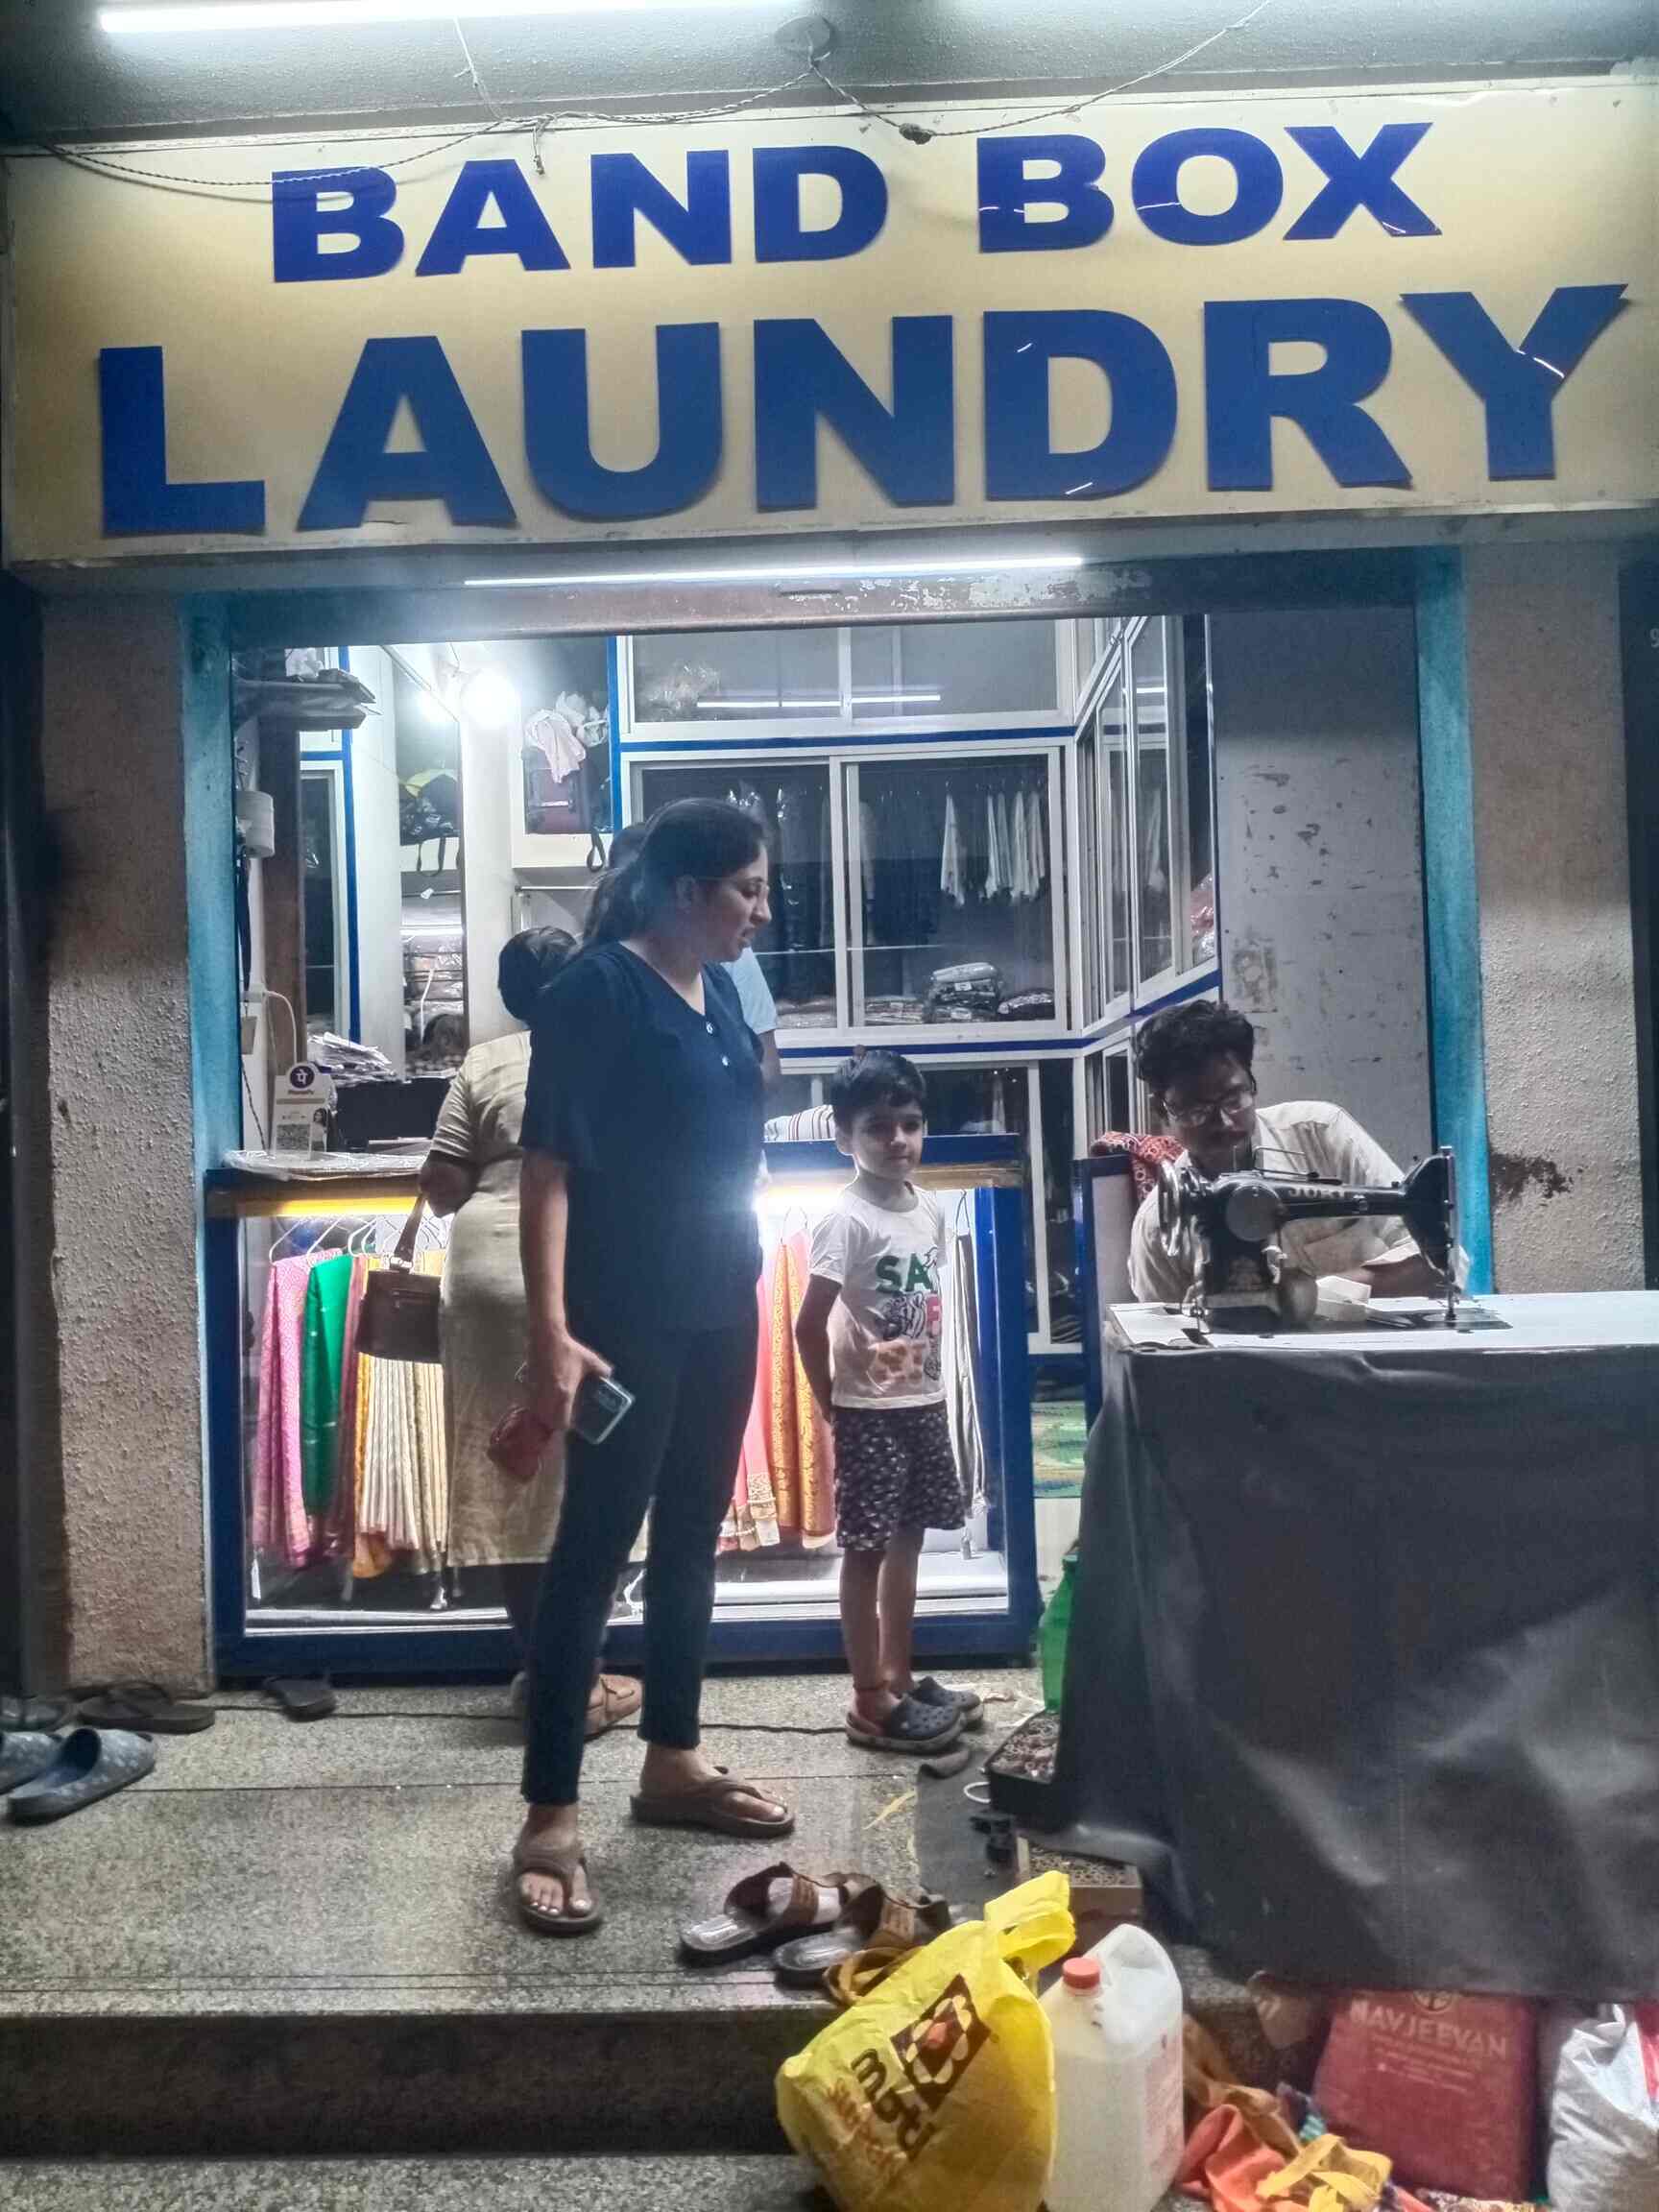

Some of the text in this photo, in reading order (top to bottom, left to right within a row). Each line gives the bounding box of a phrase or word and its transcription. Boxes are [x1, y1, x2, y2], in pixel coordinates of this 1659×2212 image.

[272, 122, 1442, 283] BAND BOX
[99, 283, 1629, 537] LAUNDRY
